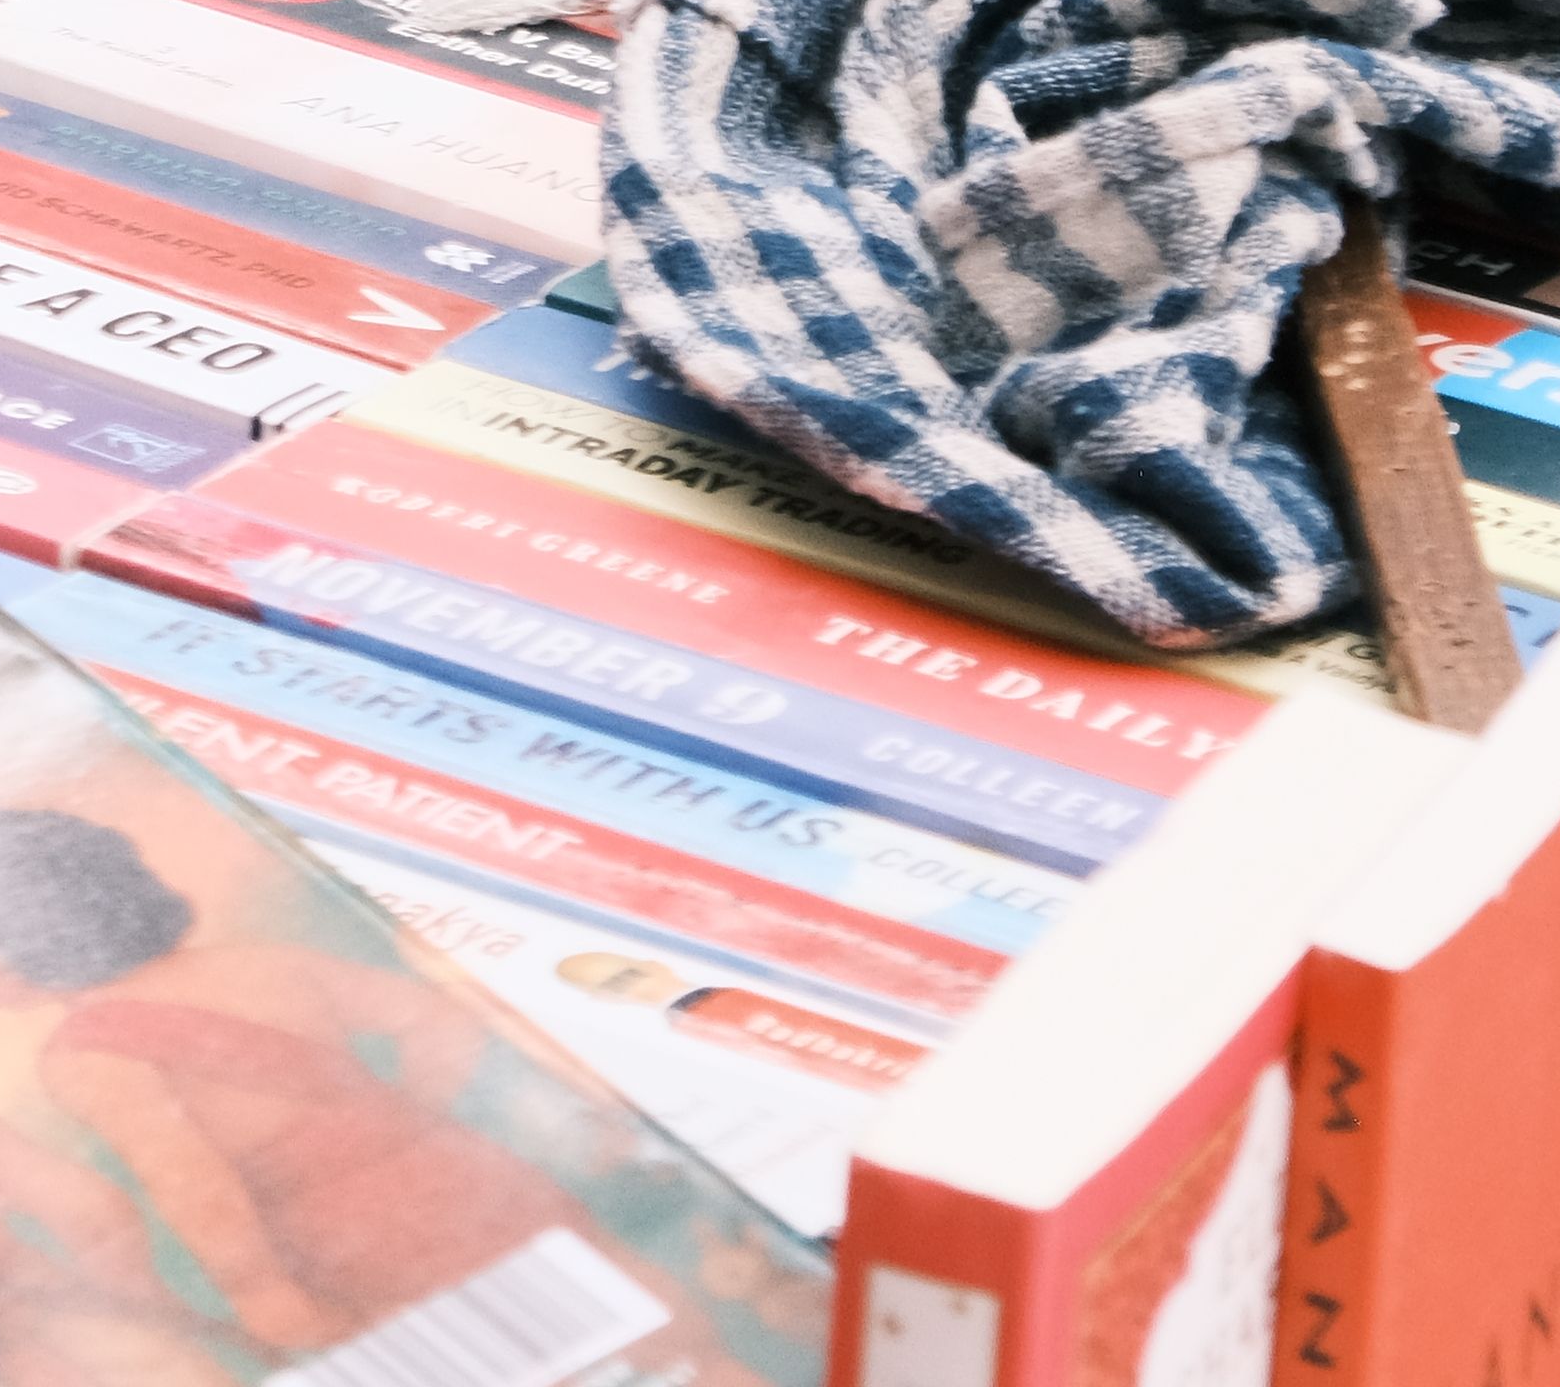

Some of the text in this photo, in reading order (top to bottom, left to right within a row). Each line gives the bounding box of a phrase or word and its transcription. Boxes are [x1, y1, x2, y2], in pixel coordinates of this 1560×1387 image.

[280, 93, 404, 137] ANA
[18, 286, 107, 320] A
[100, 309, 279, 374] CEO
[480, 410, 751, 495] INTRADAY
[259, 541, 1144, 834] NOVEMBER 9 COLLEEN
[812, 614, 1240, 763] THE DAILY
[311, 749, 582, 862] PATIENT
[516, 730, 727, 813] WITH
